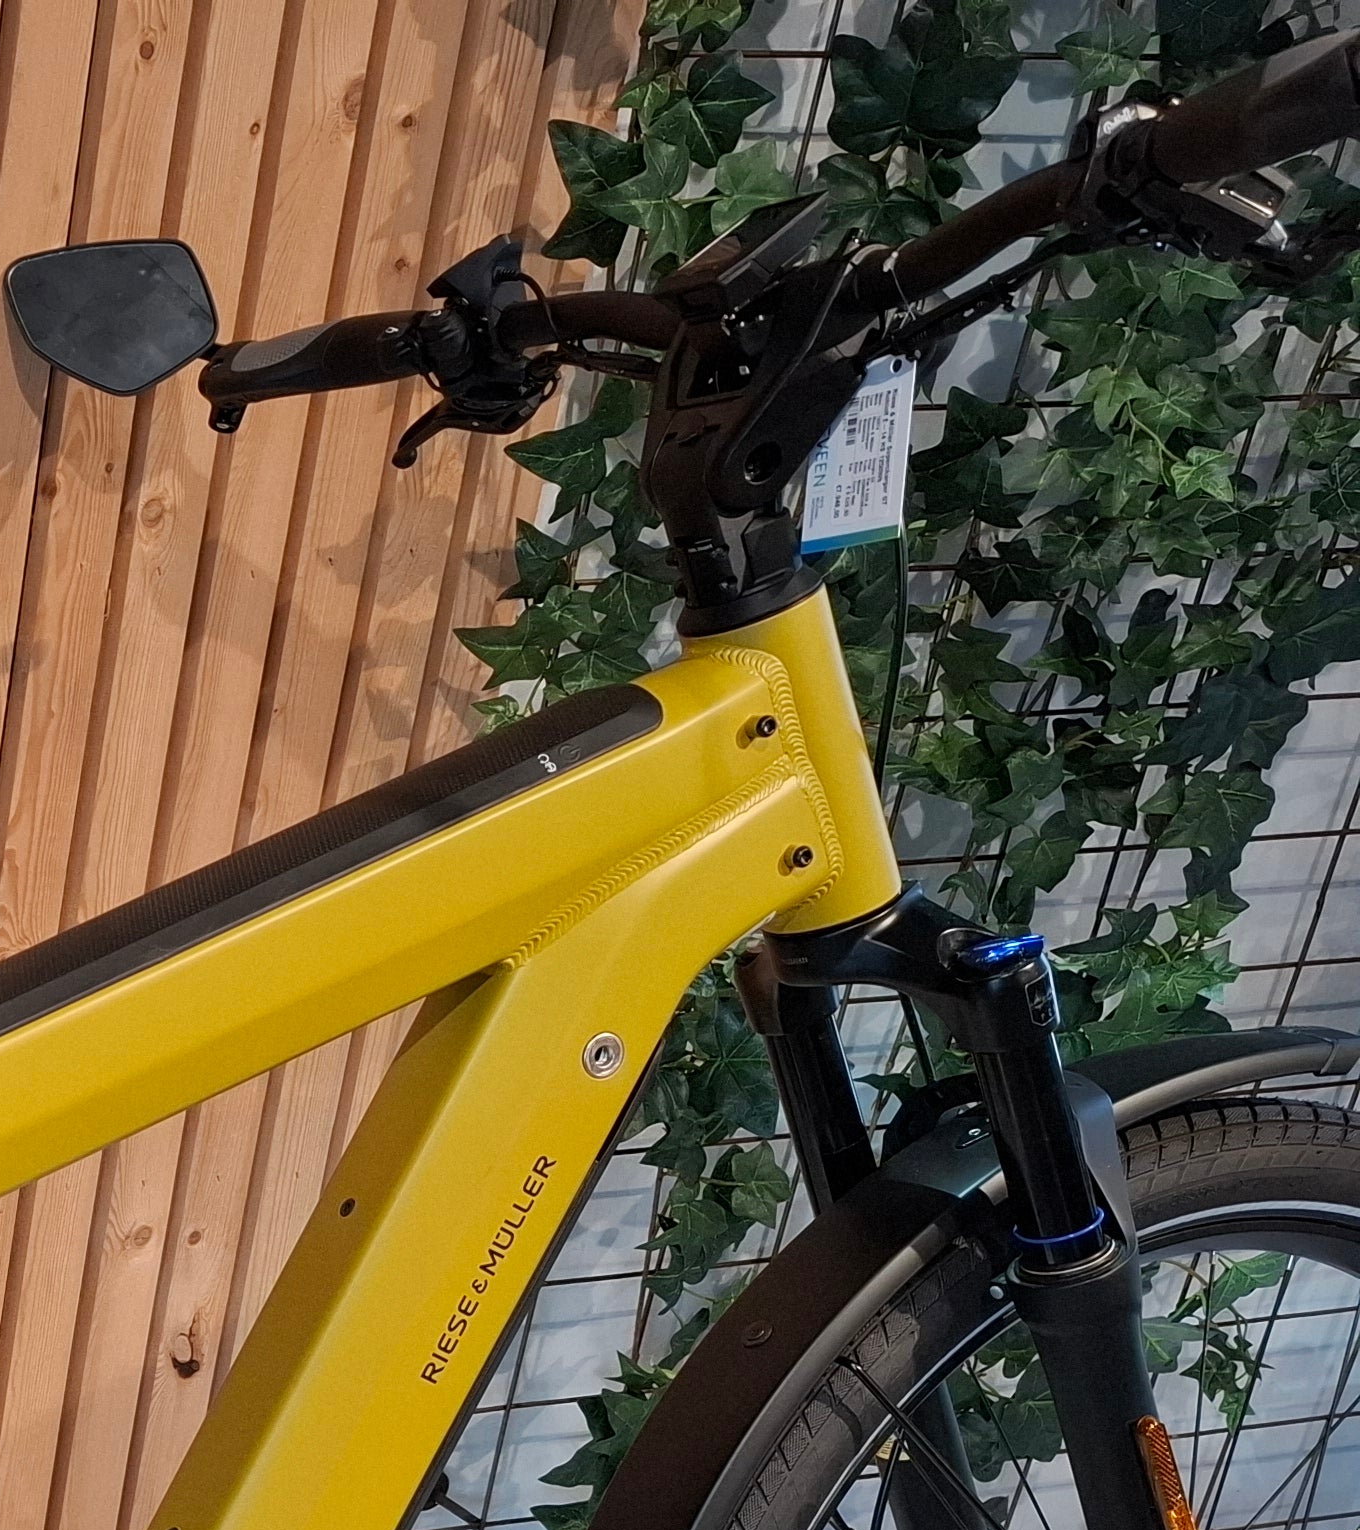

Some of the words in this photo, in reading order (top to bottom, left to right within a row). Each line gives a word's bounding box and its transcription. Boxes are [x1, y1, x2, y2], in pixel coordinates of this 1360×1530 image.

[479, 1155, 557, 1277] MÜLLER
[471, 1278, 488, 1295] &
[420, 1294, 480, 1385] RIESE
